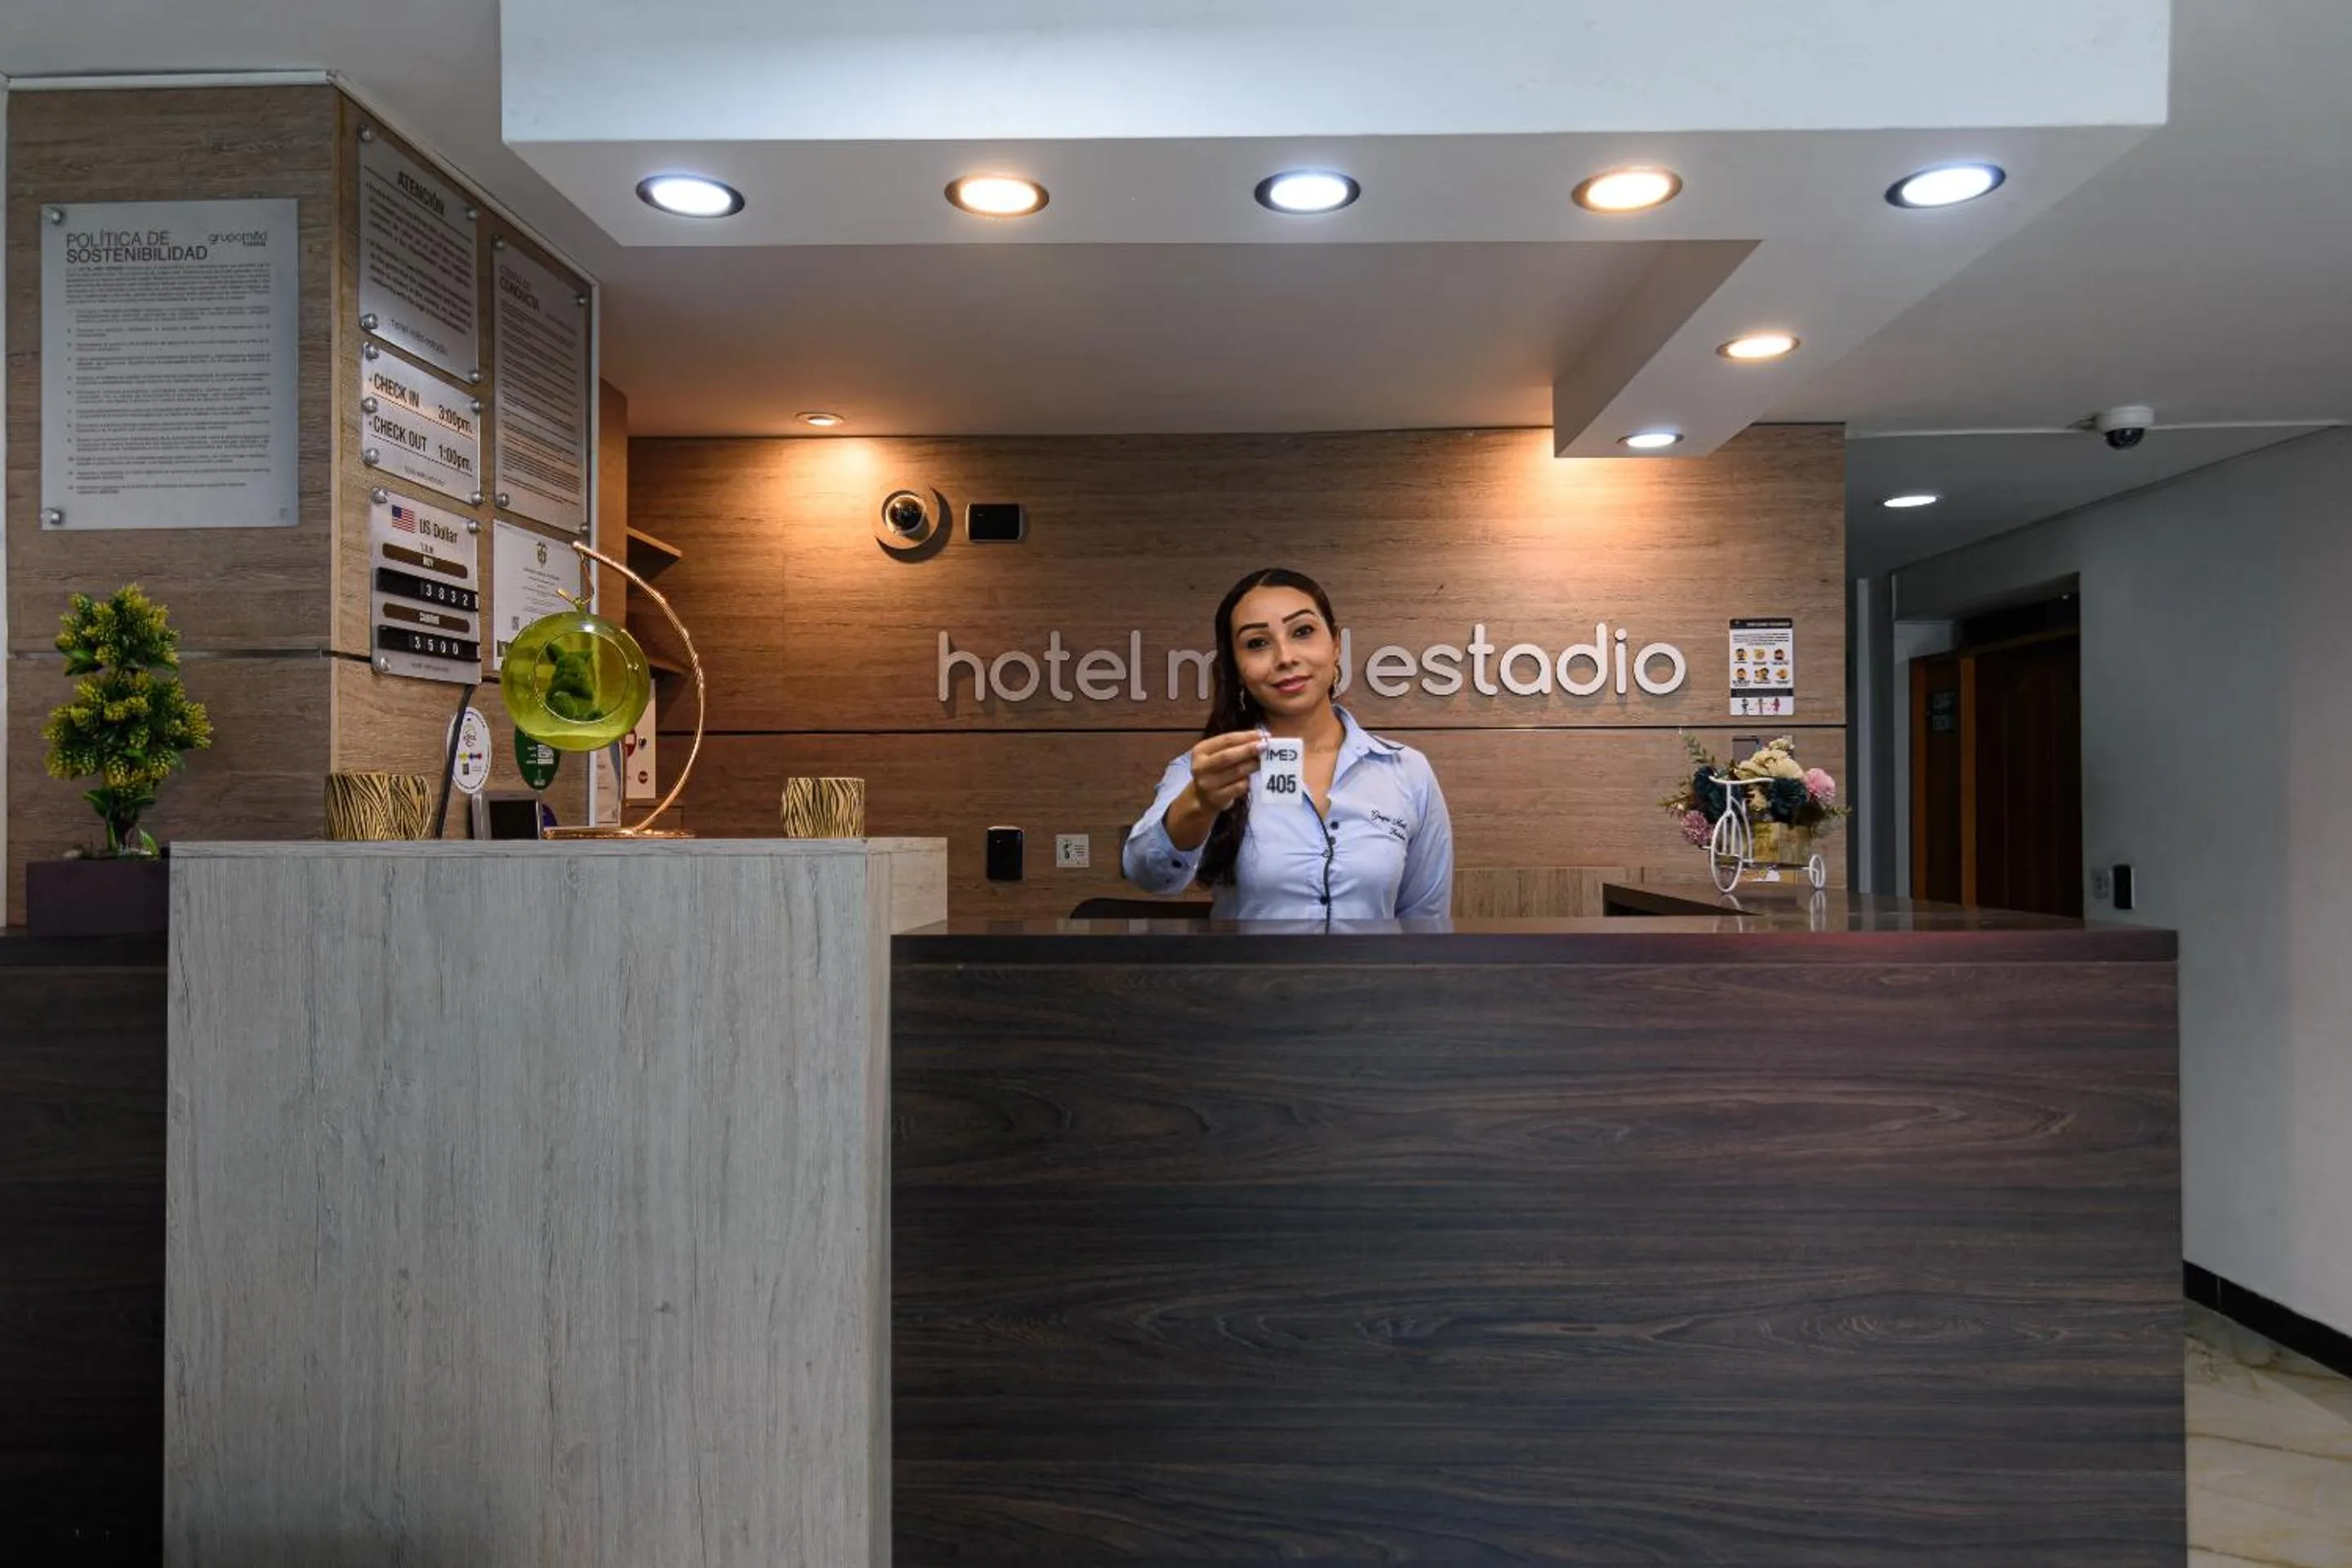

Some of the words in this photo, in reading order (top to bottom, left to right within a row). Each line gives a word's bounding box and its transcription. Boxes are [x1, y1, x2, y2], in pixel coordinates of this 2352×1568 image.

[66, 229, 141, 248] POLÍTICA
[147, 231, 171, 247] DE
[66, 246, 208, 264] SOSTENIBILIDAD
[374, 373, 407, 403] CHECK
[408, 390, 420, 408] IN
[373, 415, 407, 443] CHECK
[409, 431, 428, 452] OUT
[419, 518, 431, 536] US
[433, 523, 457, 544] Dollar
[414, 636, 459, 655] 3500
[938, 629, 1147, 702] hotel
[1365, 622, 1686, 697] estadio
[1266, 773, 1297, 794] 405
